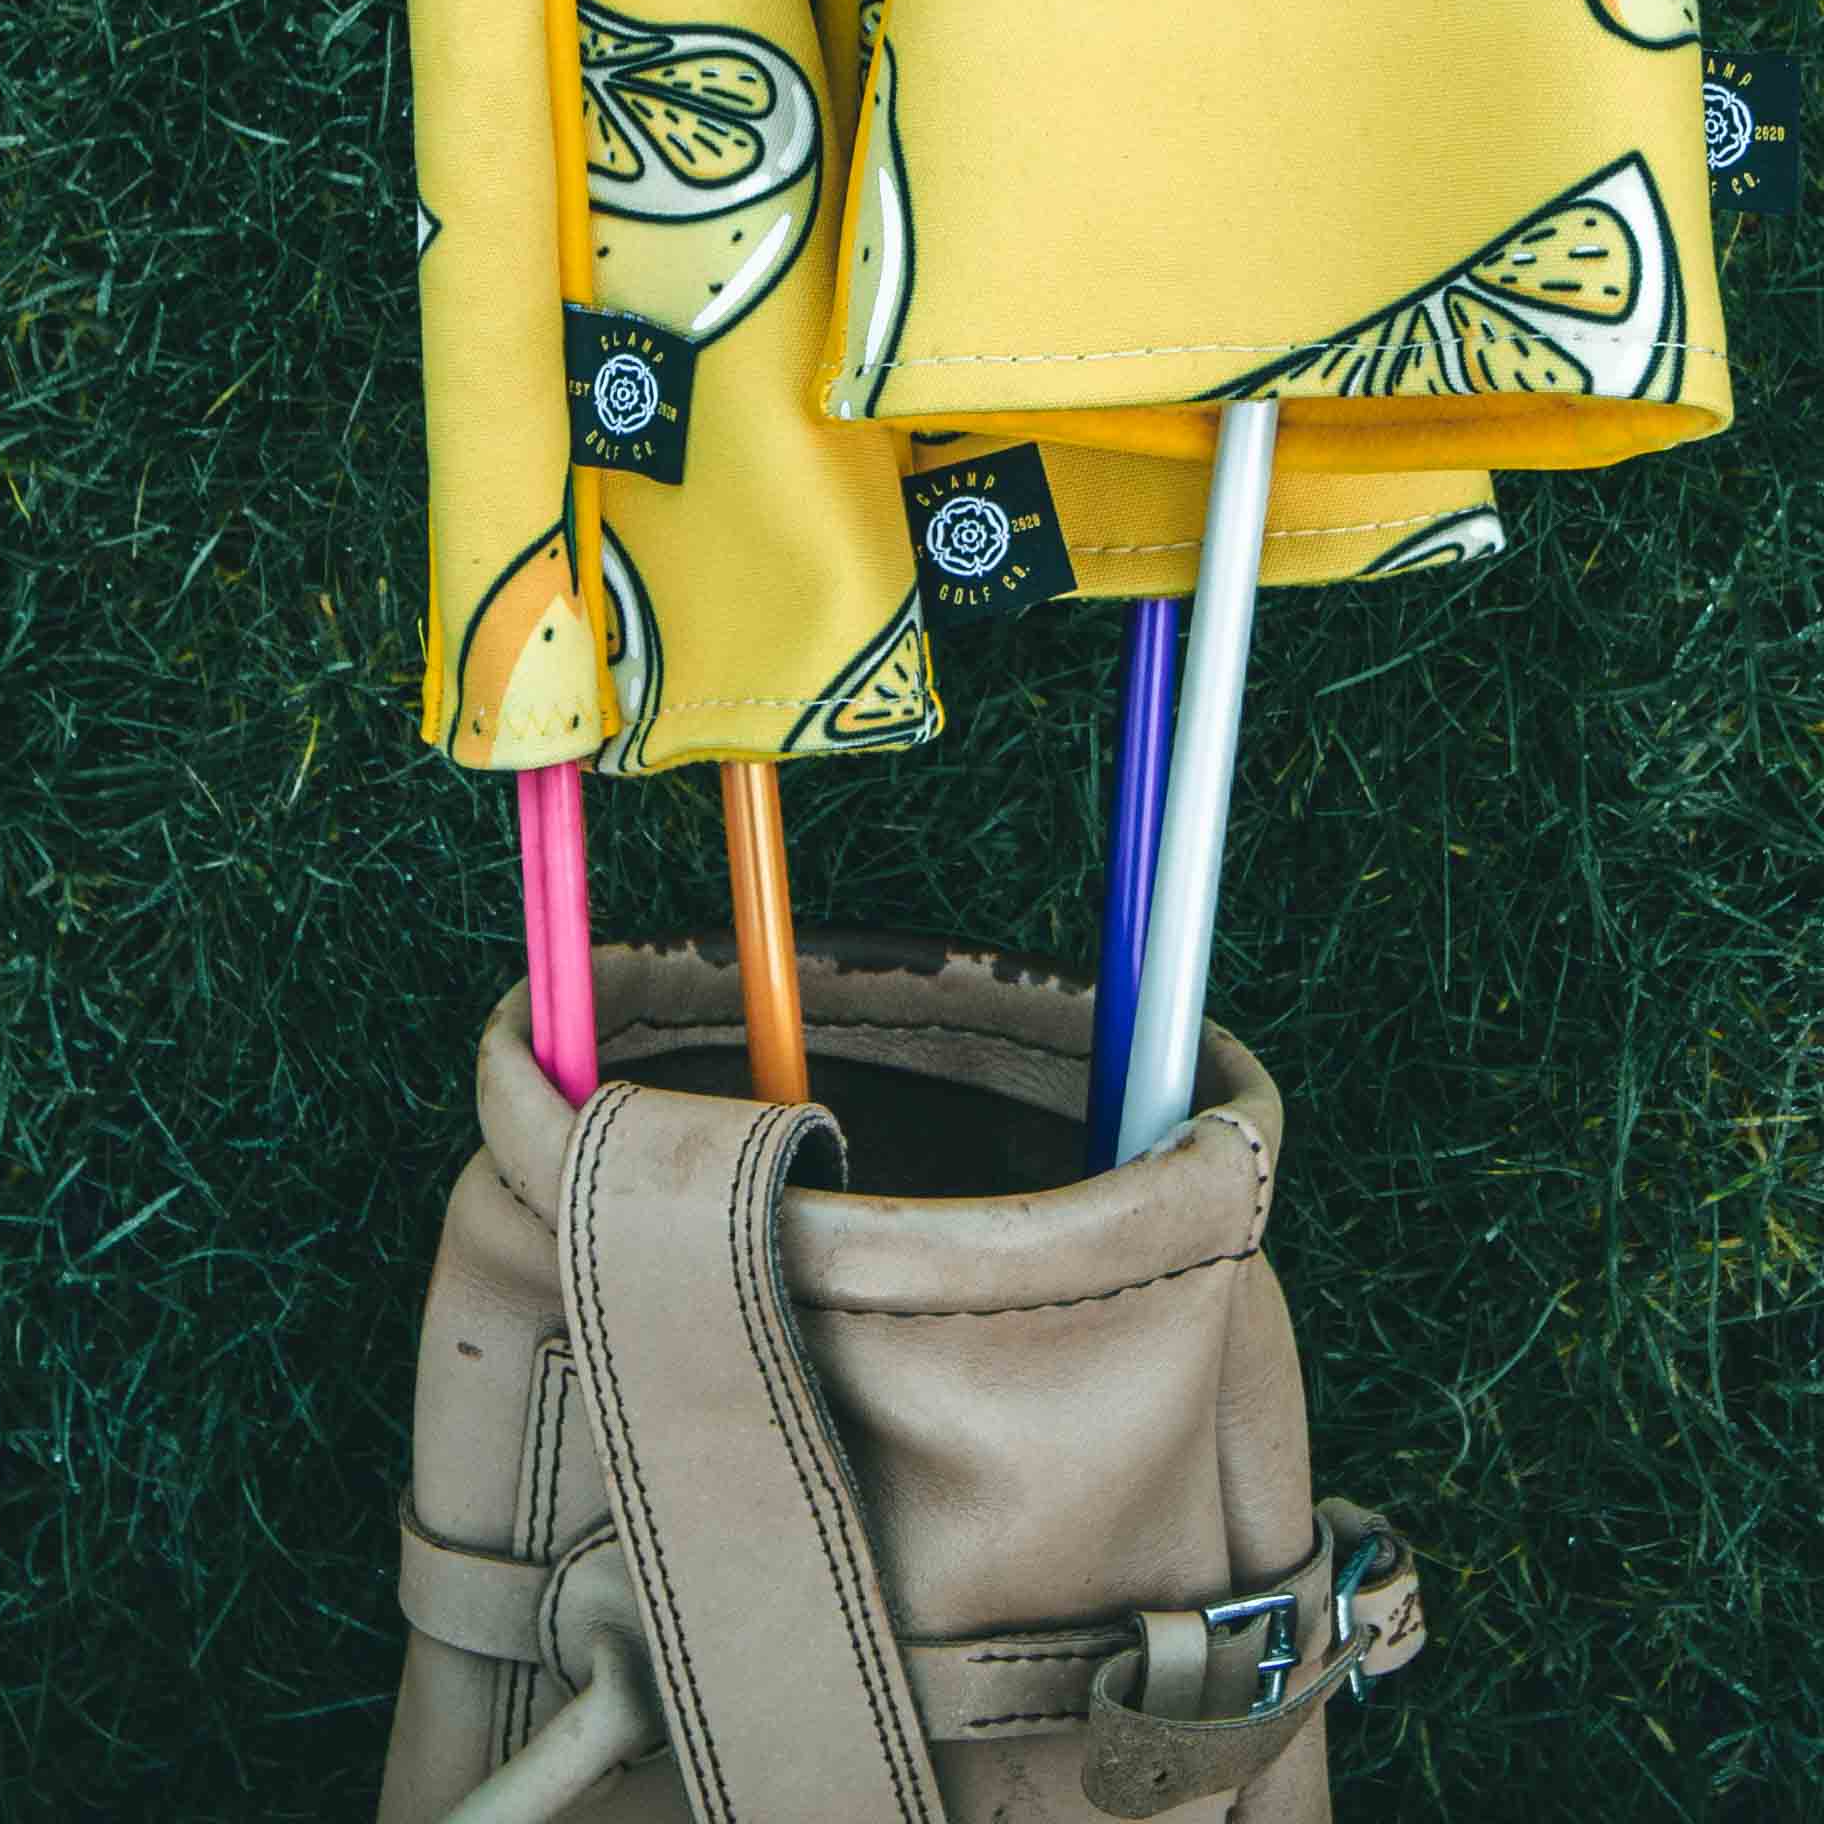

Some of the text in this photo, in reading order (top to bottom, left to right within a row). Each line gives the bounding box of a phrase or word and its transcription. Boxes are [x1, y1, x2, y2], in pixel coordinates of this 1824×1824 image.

[1706, 58, 1753, 86] AMP
[1754, 125, 1785, 142] 2020
[599, 331, 664, 364] CLAMP
[568, 380, 591, 397] EST
[585, 429, 620, 461] GOLF
[915, 471, 996, 507] CLAMP
[1011, 513, 1041, 533] 2020
[938, 583, 993, 605] GOLF
